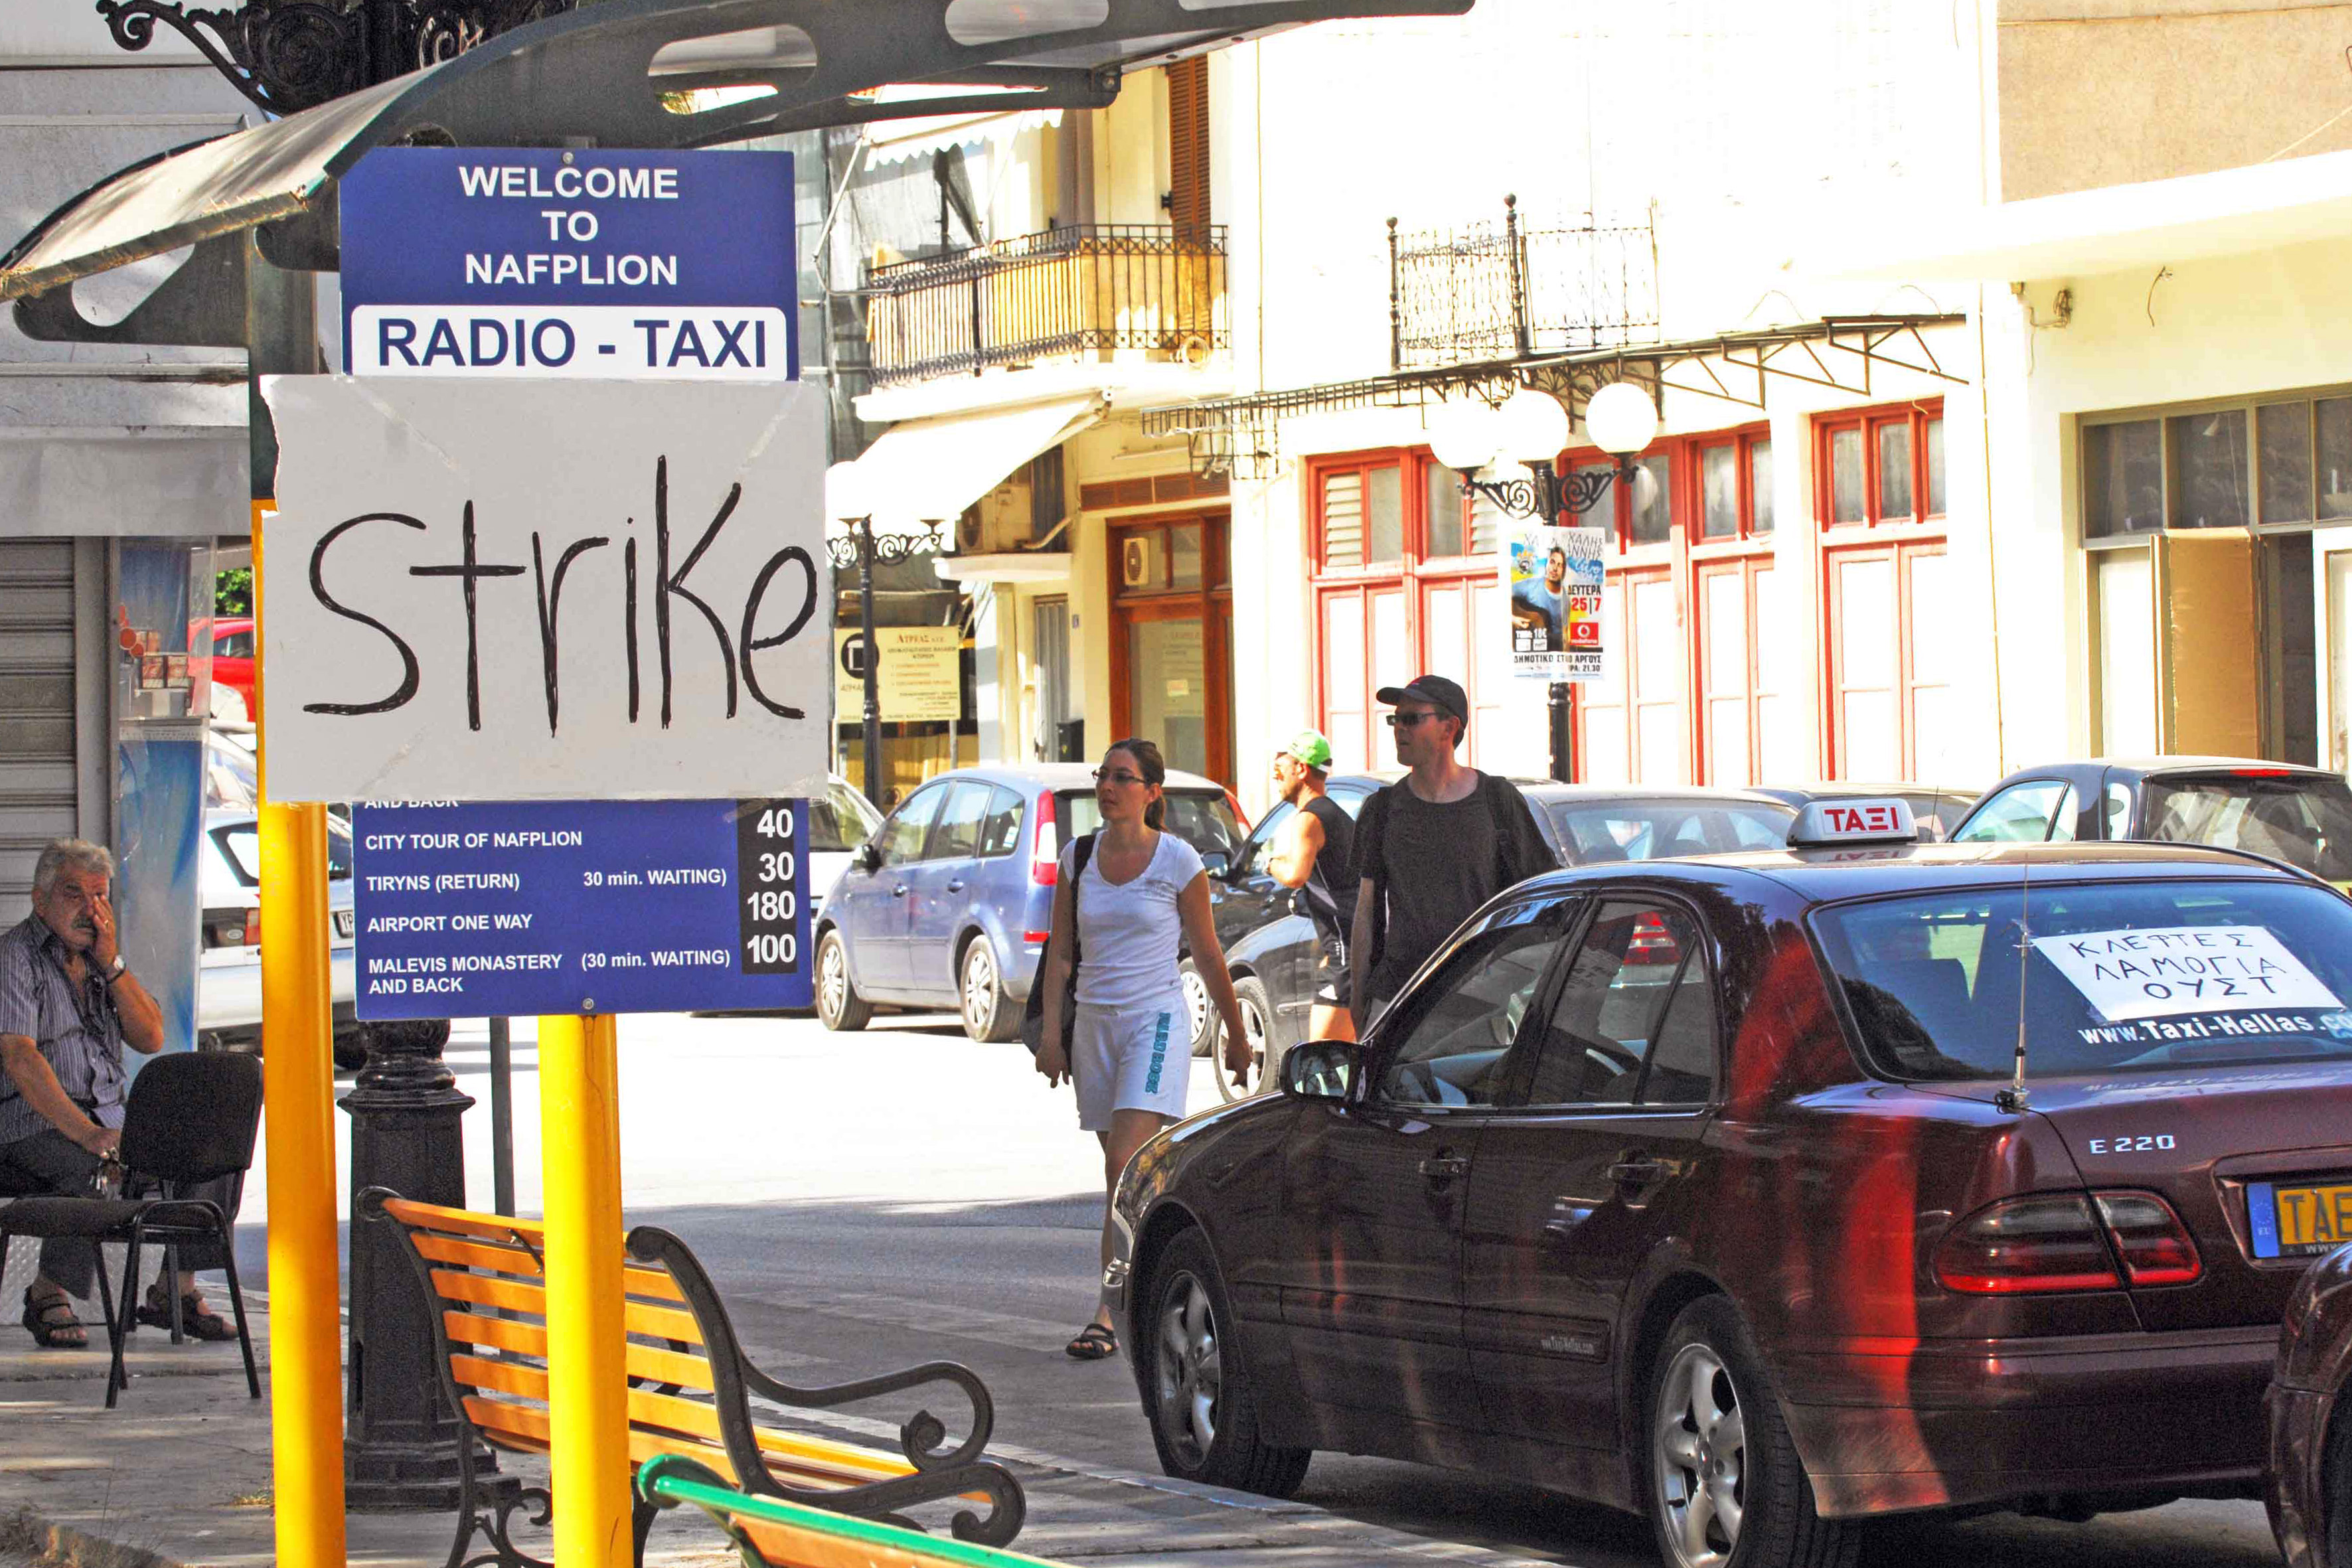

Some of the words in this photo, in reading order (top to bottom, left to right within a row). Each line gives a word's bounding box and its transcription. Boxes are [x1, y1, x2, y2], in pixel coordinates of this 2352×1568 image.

[459, 166, 678, 199] WELCOME
[542, 211, 598, 241] TO
[466, 254, 677, 285] NAFPLION
[378, 318, 576, 368] RADIO
[634, 319, 766, 367] TAXI
[1567, 584, 1601, 595] ΔΕΥΤΕΡΑ
[1514, 655, 1553, 663] ΔΗΜΟΤΙΚΟ
[757, 809, 793, 838] 40
[1824, 807, 1899, 832] ΤΑΞΙ
[365, 834, 406, 850] CITY
[410, 834, 460, 849] TOUR
[465, 832, 489, 848] OF
[494, 831, 582, 847] NAFPLION
[584, 872, 603, 886] 30
[607, 871, 643, 886] min.
[648, 868, 727, 887] WAITING)
[759, 852, 795, 882] 30
[366, 875, 430, 892] TIRYNS
[435, 873, 520, 893] (RETURN)
[747, 891, 796, 921] 180
[367, 916, 447, 933] AIRPORT
[451, 915, 489, 931] ONE
[494, 913, 533, 929] WAY
[747, 933, 797, 964] 100
[2069, 933, 2254, 959] ΚΛΕΦΤΕΣ
[369, 957, 447, 974] MALEVIS
[452, 955, 562, 971] MONASTERY
[582, 953, 606, 972] (30
[611, 952, 647, 967] min.
[651, 949, 730, 969] WAITING)
[2095, 957, 2287, 980] ΛΑΜΟΓΙΑ
[369, 979, 407, 994] AND
[413, 977, 463, 993] BACK
[2144, 977, 2276, 999] ΟΥΣΤ
